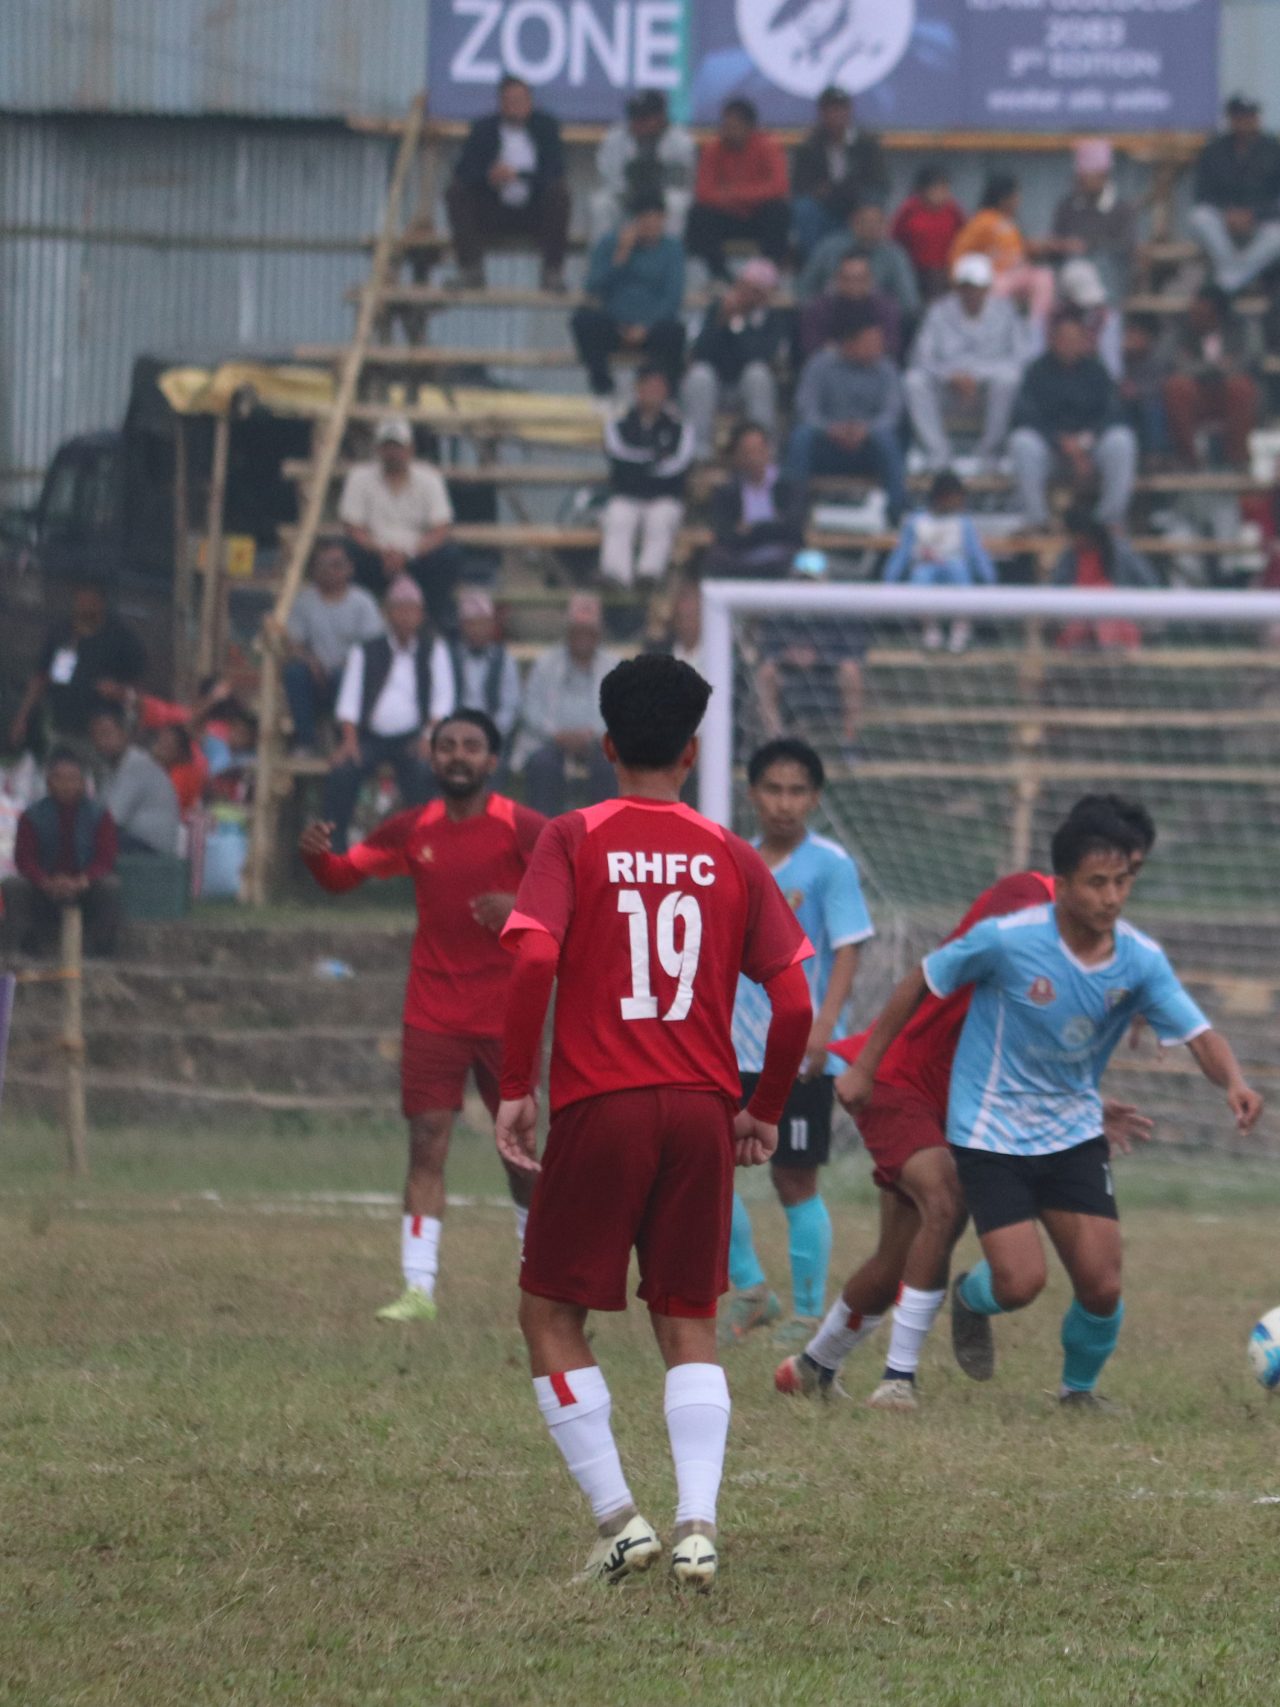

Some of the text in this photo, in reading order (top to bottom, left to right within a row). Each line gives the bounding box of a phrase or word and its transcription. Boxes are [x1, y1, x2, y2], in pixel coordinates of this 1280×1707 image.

[450, 0, 682, 88] ZONE
[1049, 50, 1161, 78] EDITION
[607, 852, 715, 886] RHFC
[617, 889, 702, 1021] 19
